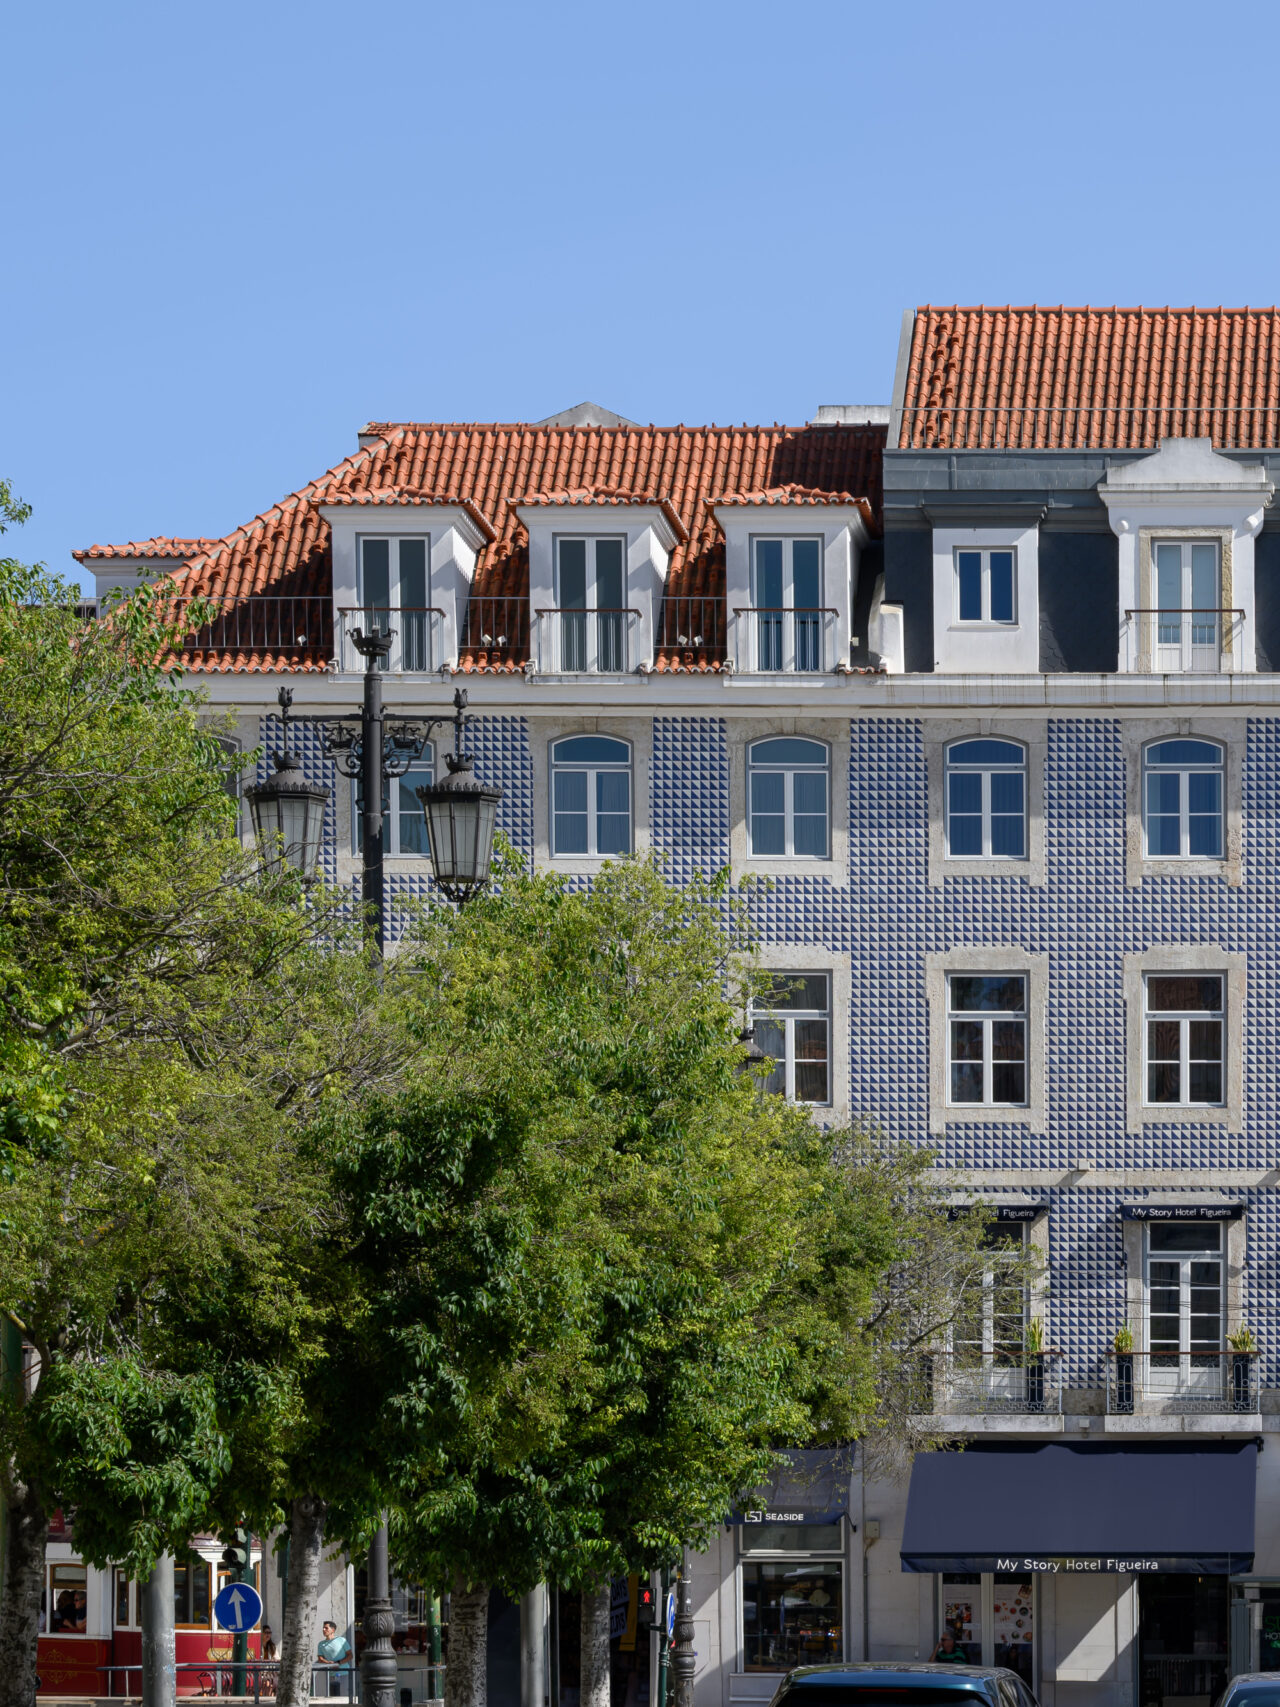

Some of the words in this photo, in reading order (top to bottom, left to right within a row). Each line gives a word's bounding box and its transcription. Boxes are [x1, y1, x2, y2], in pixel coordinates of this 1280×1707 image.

[1003, 1208, 1035, 1218] Figueira
[1132, 1208, 1147, 1217] My
[1149, 1208, 1172, 1217] Story
[1175, 1208, 1197, 1216] Hotel
[1200, 1208, 1231, 1218] Figueira
[765, 1513, 804, 1521] SEASIDE
[997, 1559, 1018, 1571] My
[1023, 1559, 1060, 1572] Story
[1066, 1559, 1101, 1570] Hotel
[1107, 1559, 1159, 1572] Figueira
